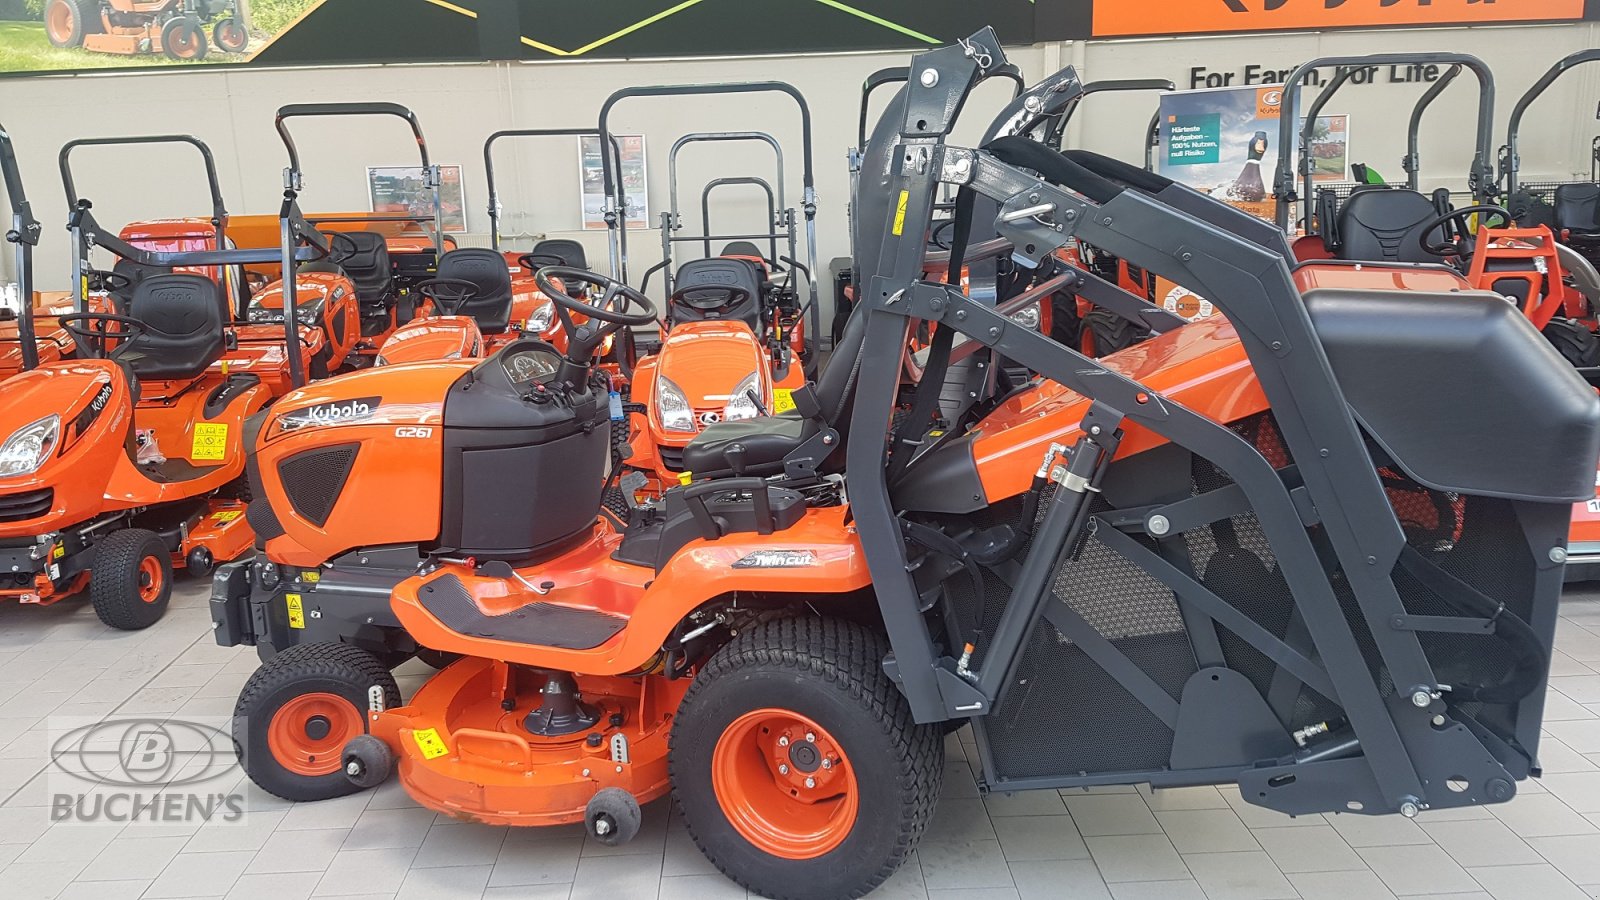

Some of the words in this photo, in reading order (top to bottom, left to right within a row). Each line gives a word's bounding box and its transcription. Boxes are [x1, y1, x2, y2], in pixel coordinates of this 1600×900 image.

[1190, 66, 1235, 90] For
[1244, 64, 1328, 88] Earh,
[1389, 63, 1440, 84] Life
[1171, 126, 1201, 134] Härteste
[1171, 134, 1204, 142] Aufgaben
[1184, 149, 1206, 157] Risiko
[91, 385, 113, 411] Kubota
[308, 400, 369, 421] Kubota
[394, 426, 433, 439] G261
